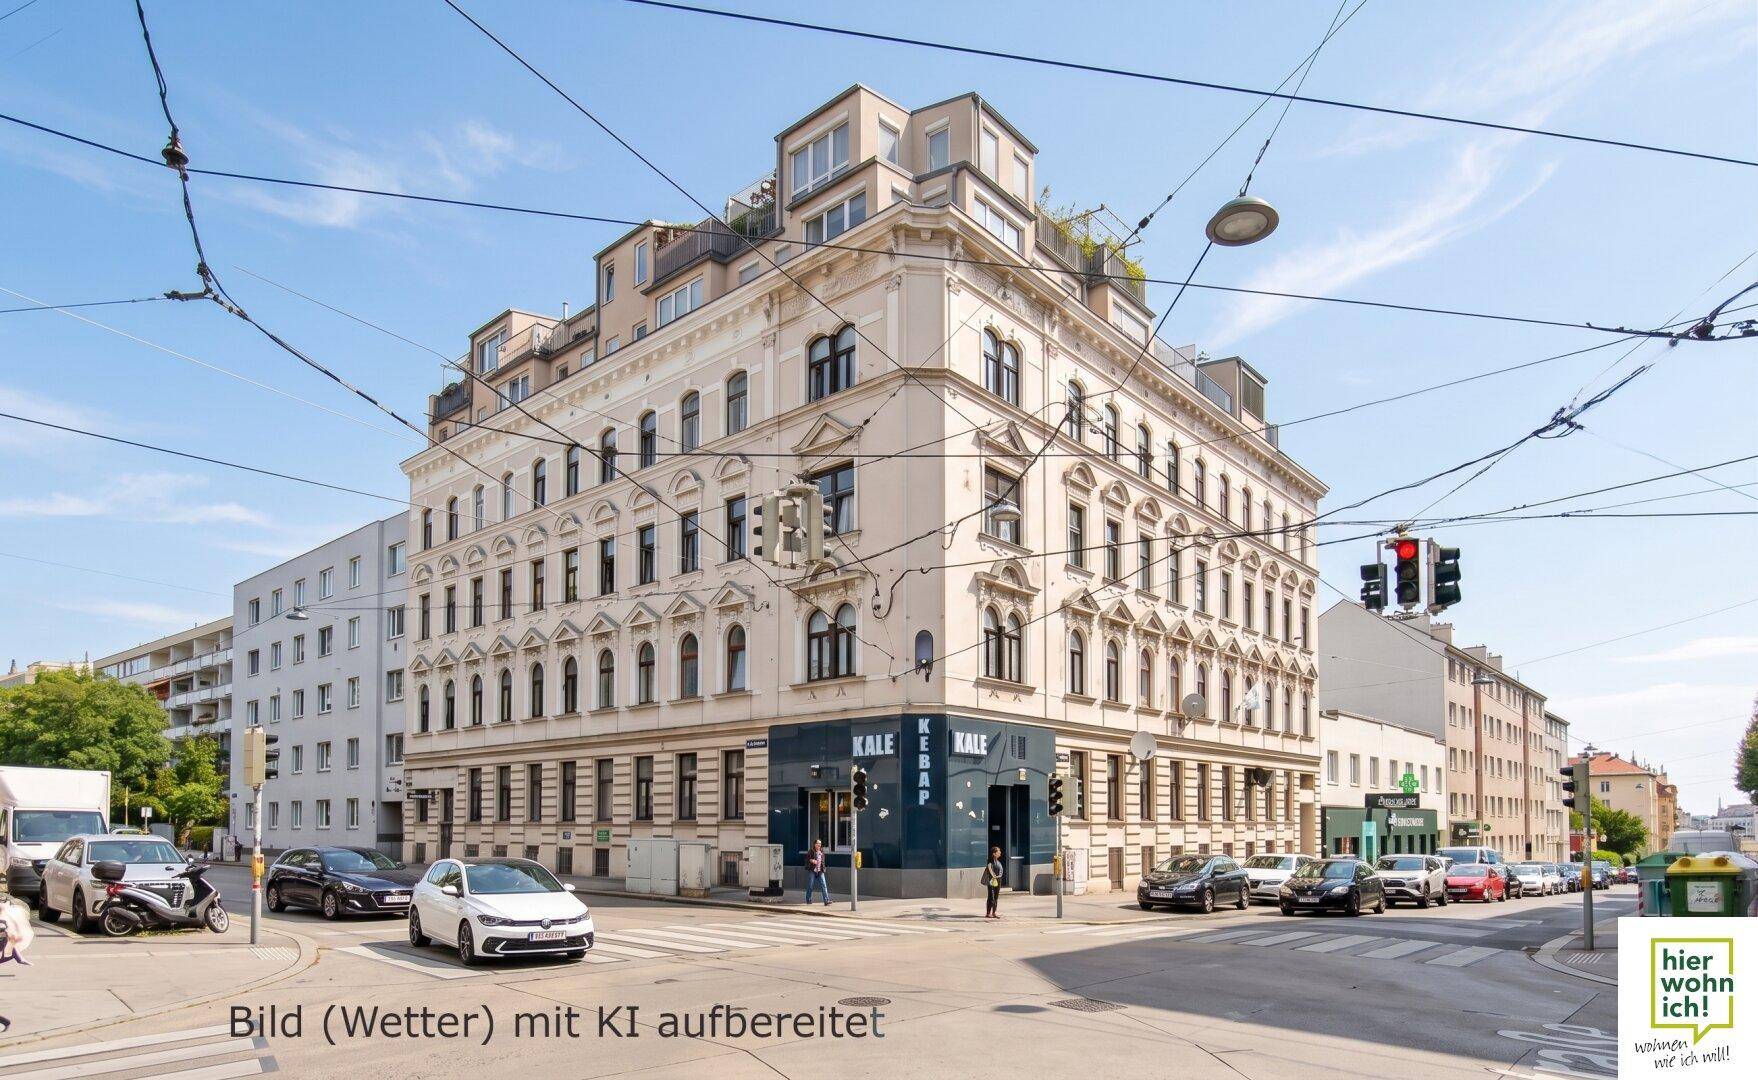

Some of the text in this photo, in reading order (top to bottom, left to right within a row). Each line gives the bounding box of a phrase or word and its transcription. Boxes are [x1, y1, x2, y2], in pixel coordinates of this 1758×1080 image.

[852, 733, 894, 757] KALE
[954, 731, 988, 756] KALE
[918, 718, 931, 805] KEBAP
